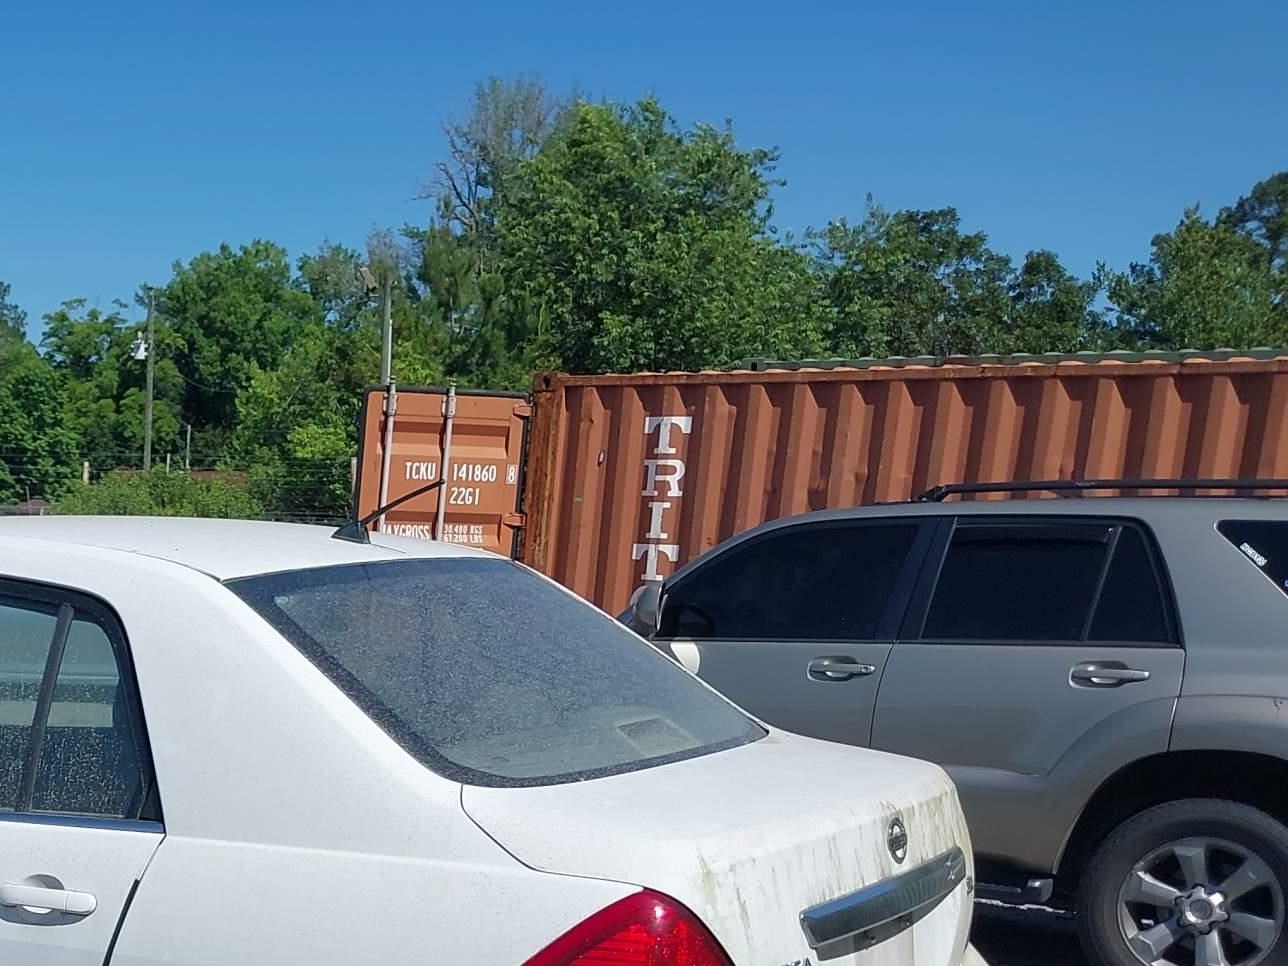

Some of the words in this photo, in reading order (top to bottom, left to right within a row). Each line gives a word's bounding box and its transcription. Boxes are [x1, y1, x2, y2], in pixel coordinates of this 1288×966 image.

[405, 462, 436, 480] TCKU
[453, 463, 497, 482] 141860
[507, 465, 516, 483] 8
[449, 487, 480, 506] 22G1
[470, 535, 483, 543] LBS
